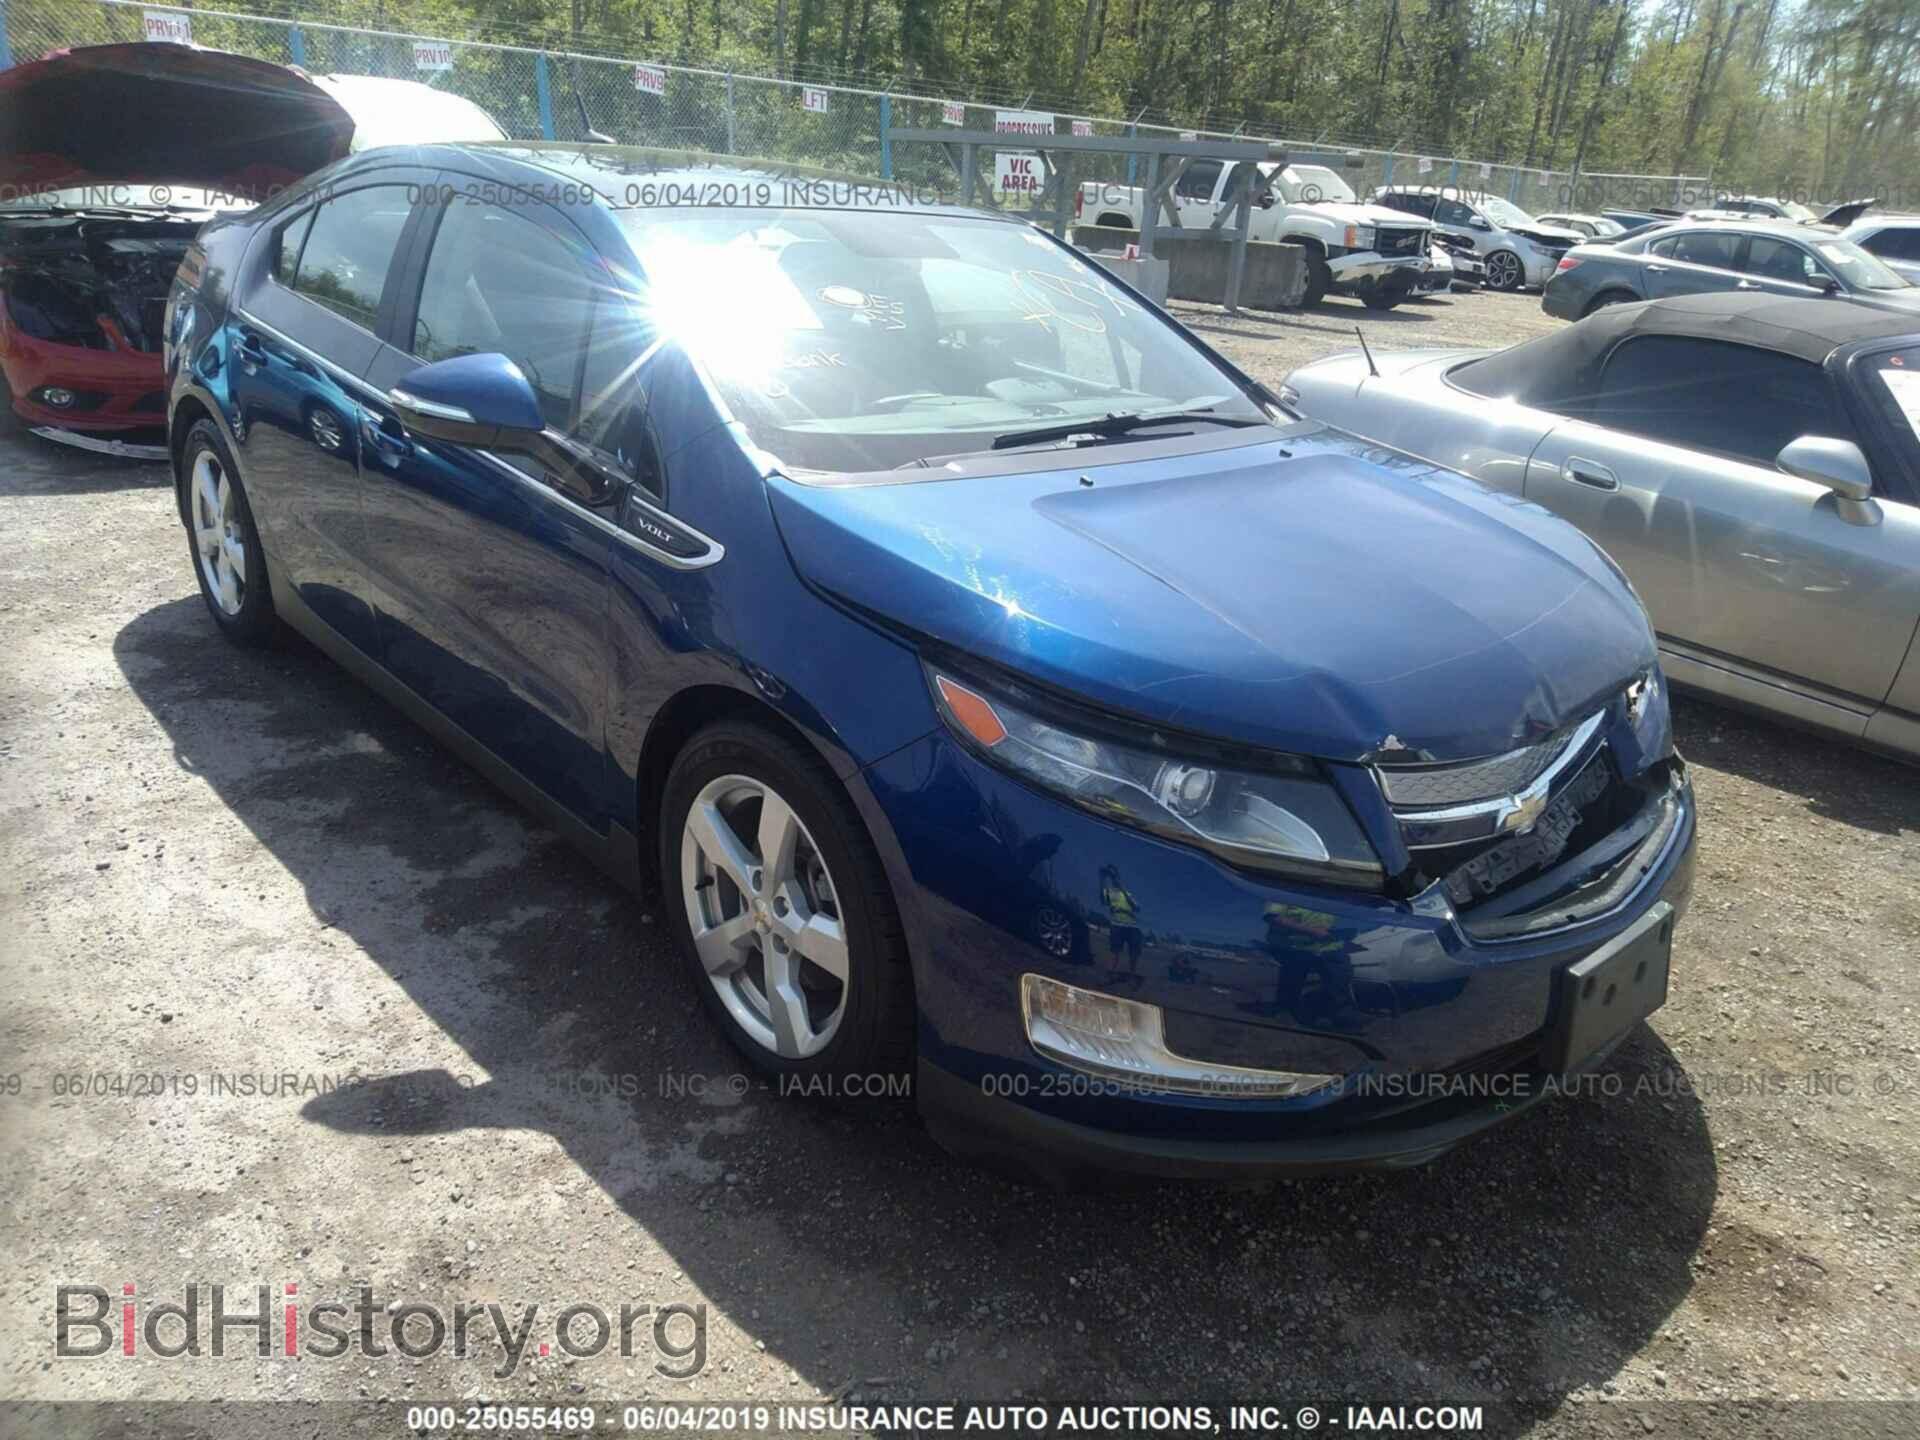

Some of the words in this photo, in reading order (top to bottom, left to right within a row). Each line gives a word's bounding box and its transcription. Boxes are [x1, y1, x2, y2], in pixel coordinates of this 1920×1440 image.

[635, 69, 664, 89] PRV9
[1010, 158, 1032, 174] VIC
[1002, 174, 1037, 191] AREA
[639, 518, 672, 542] VOLT
